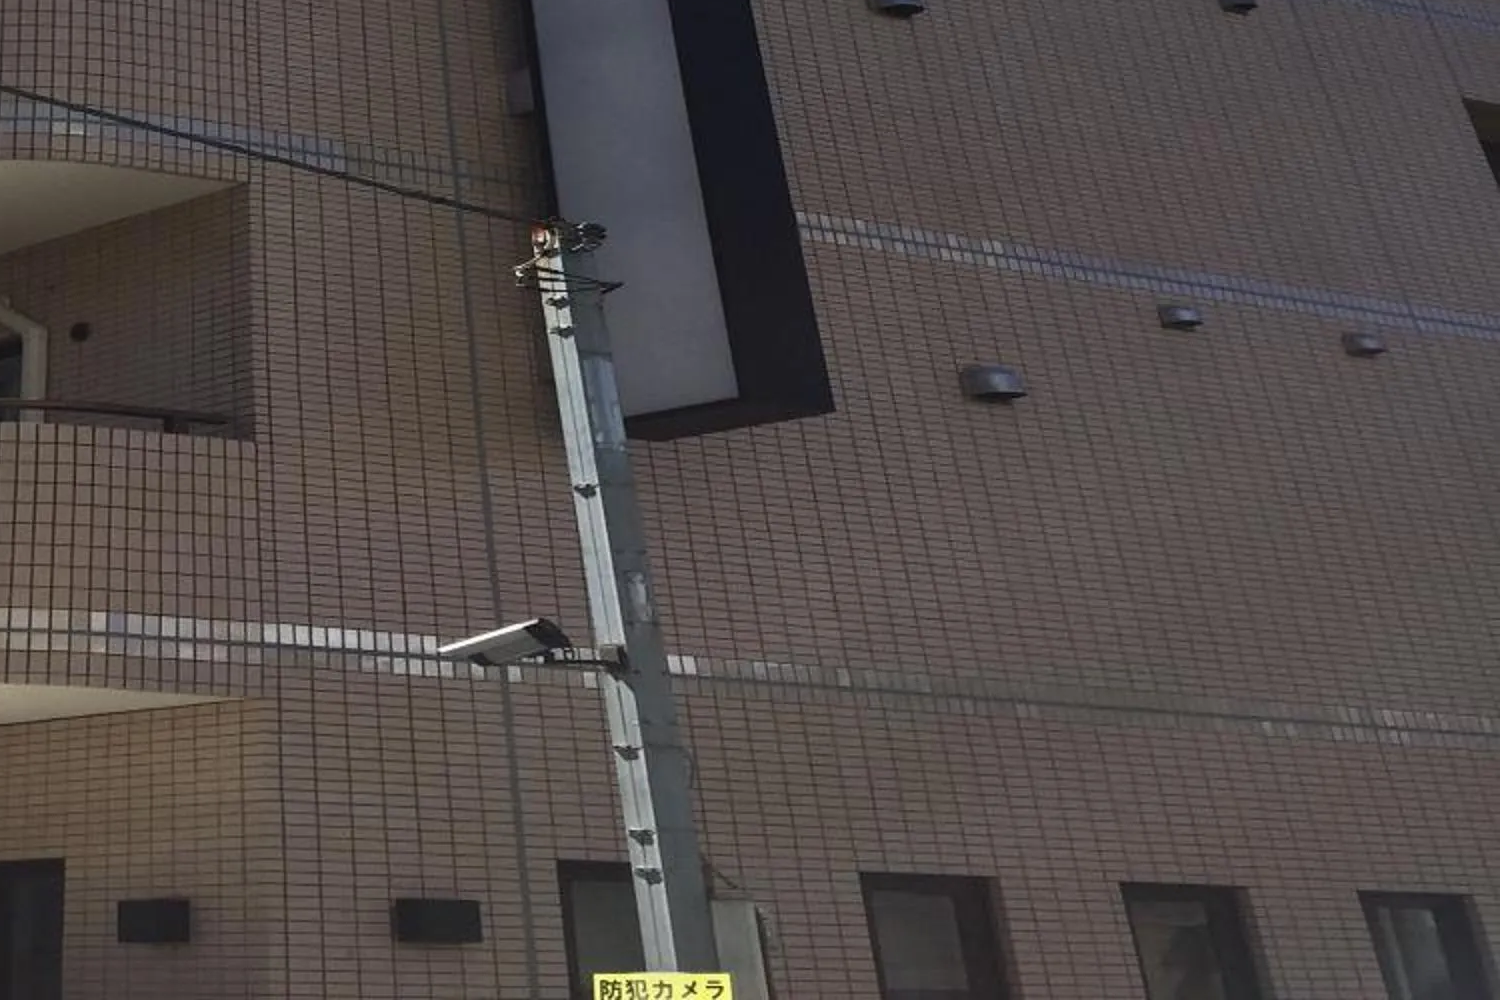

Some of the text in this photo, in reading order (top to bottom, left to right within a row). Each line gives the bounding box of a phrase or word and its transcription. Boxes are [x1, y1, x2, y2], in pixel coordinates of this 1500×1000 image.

[599, 979, 725, 1000] 防犯カメラ
